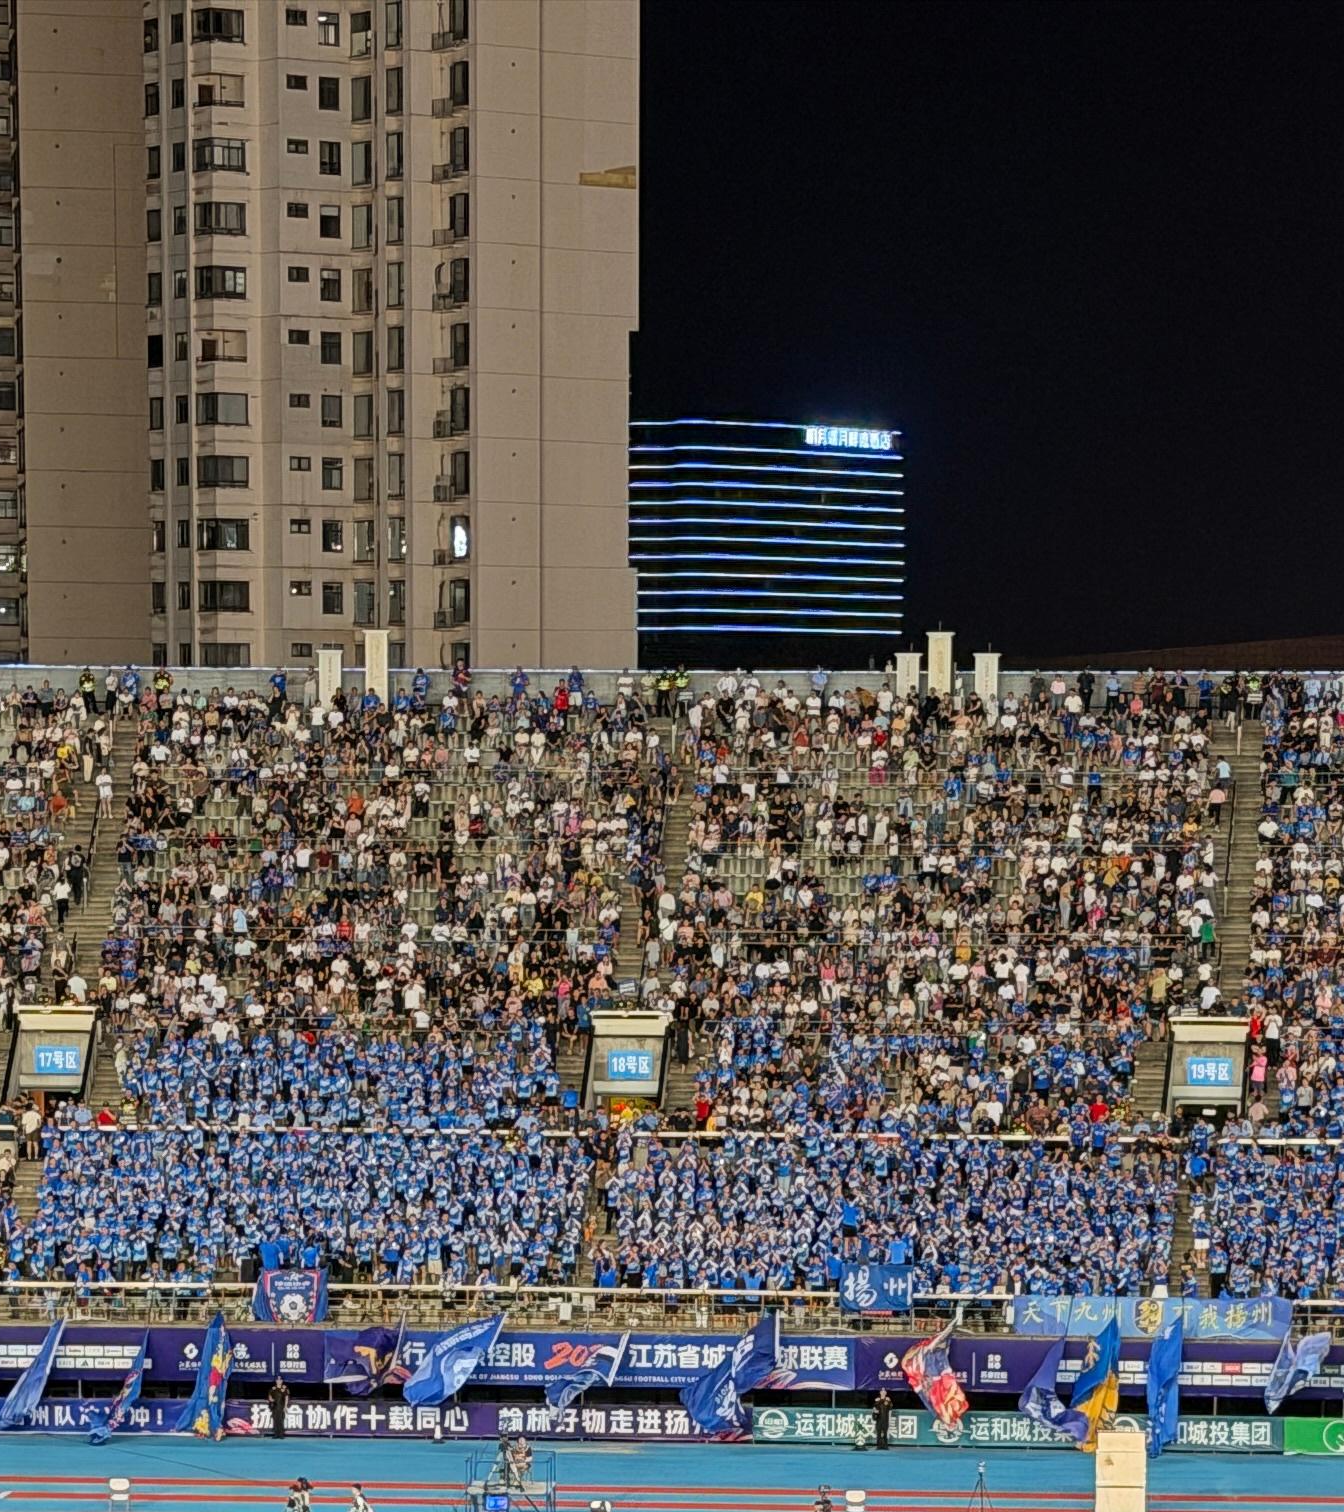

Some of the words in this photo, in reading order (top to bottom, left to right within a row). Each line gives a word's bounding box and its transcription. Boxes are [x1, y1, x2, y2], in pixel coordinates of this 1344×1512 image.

[38, 1050, 78, 1069] 17号区
[611, 1055, 651, 1074] 18号区
[1190, 1061, 1232, 1080] 19号区
[629, 1344, 848, 1371] 江苏省城球联赛
[498, 1407, 701, 1435] 榆林好物走进扬
[1147, 1419, 1271, 1446] 城投集团
